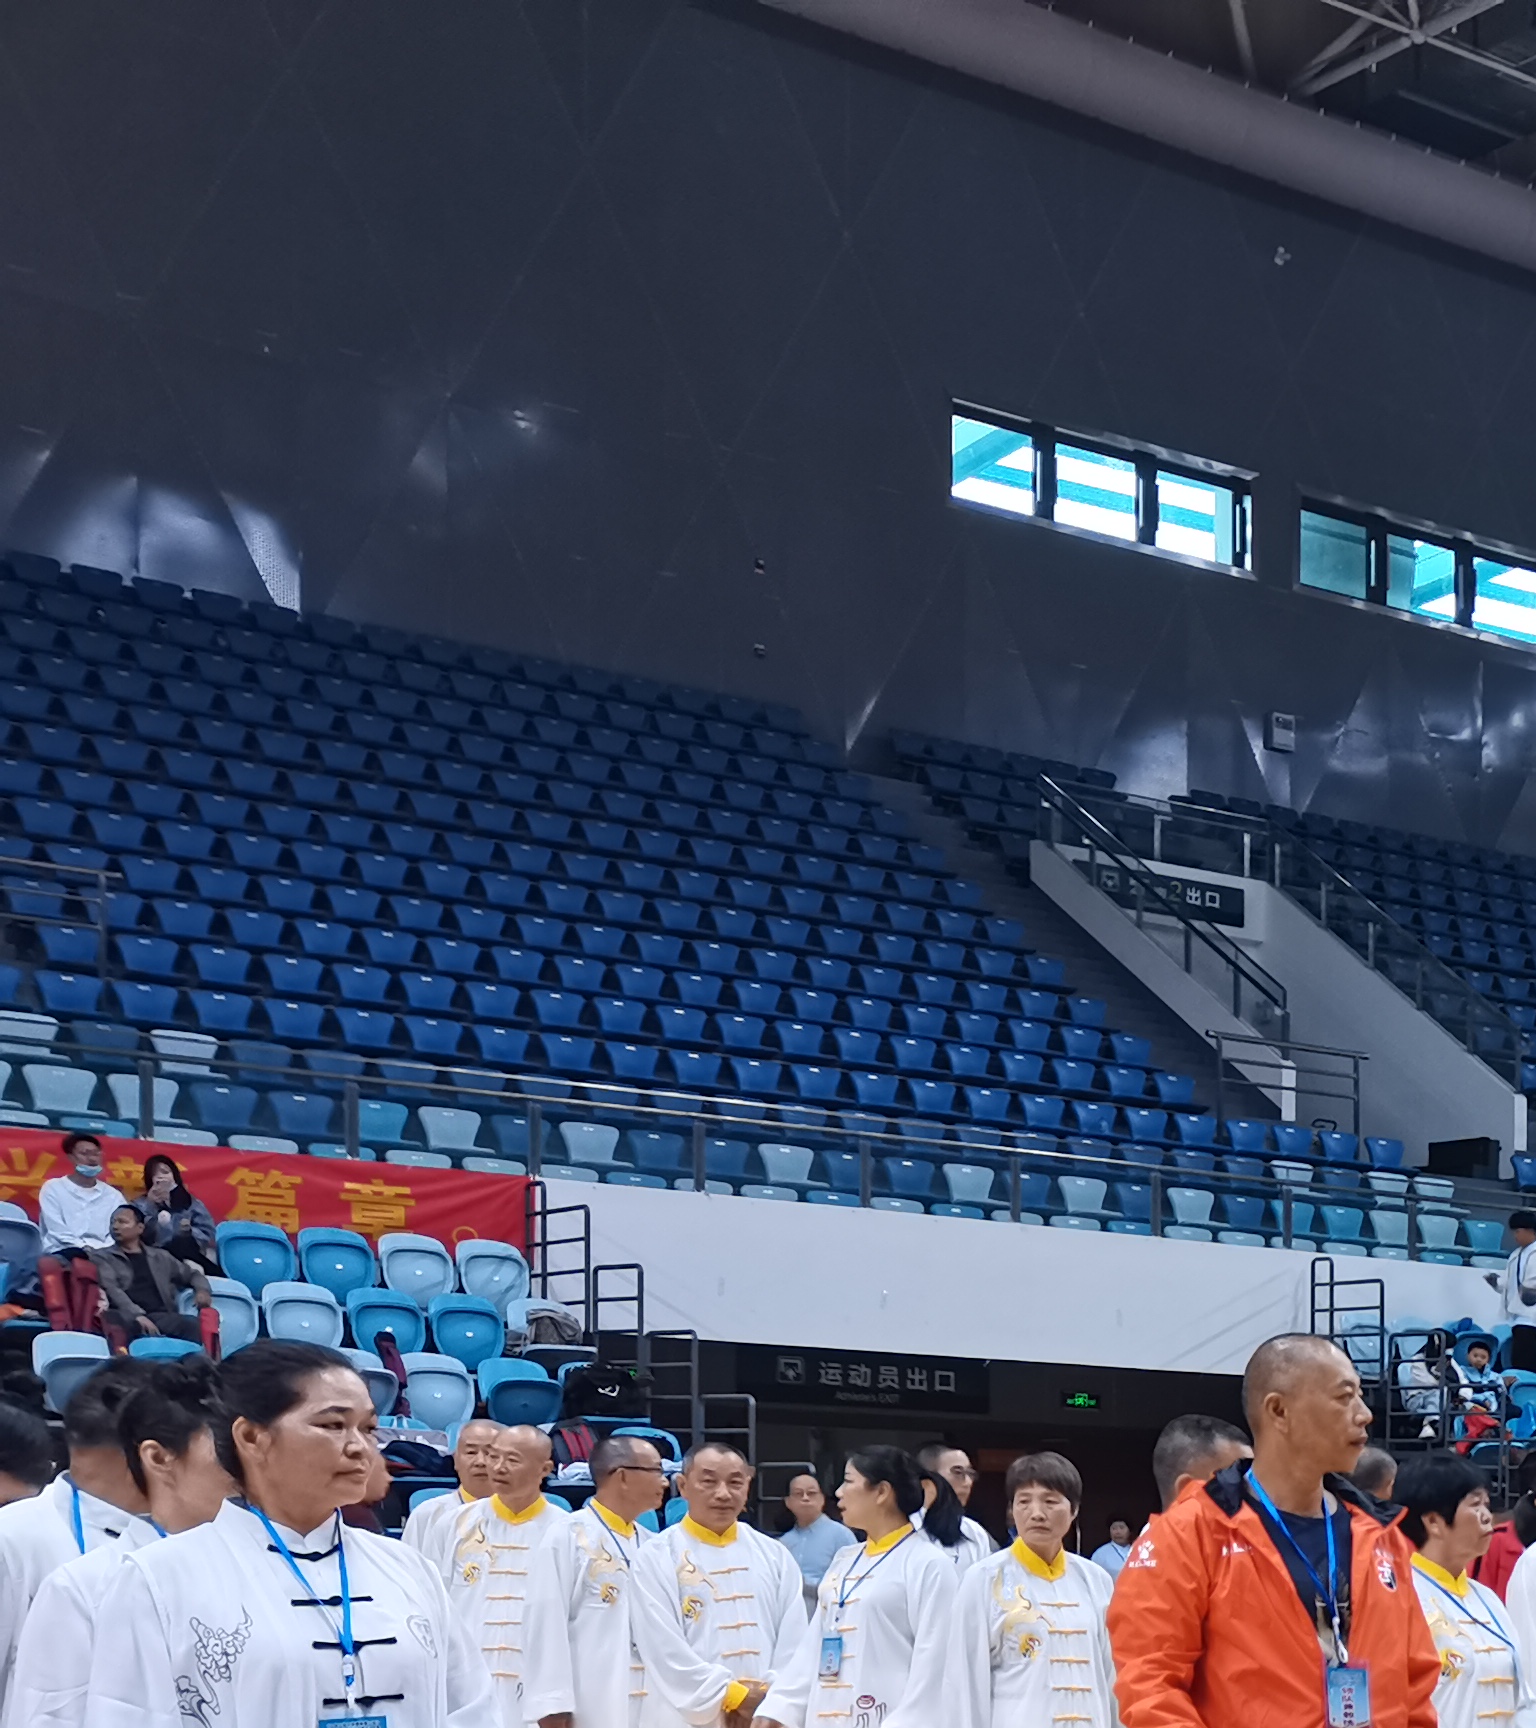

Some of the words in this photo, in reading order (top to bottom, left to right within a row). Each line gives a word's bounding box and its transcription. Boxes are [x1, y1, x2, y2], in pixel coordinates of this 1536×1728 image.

[817, 1360, 957, 1393] 运动员出口
